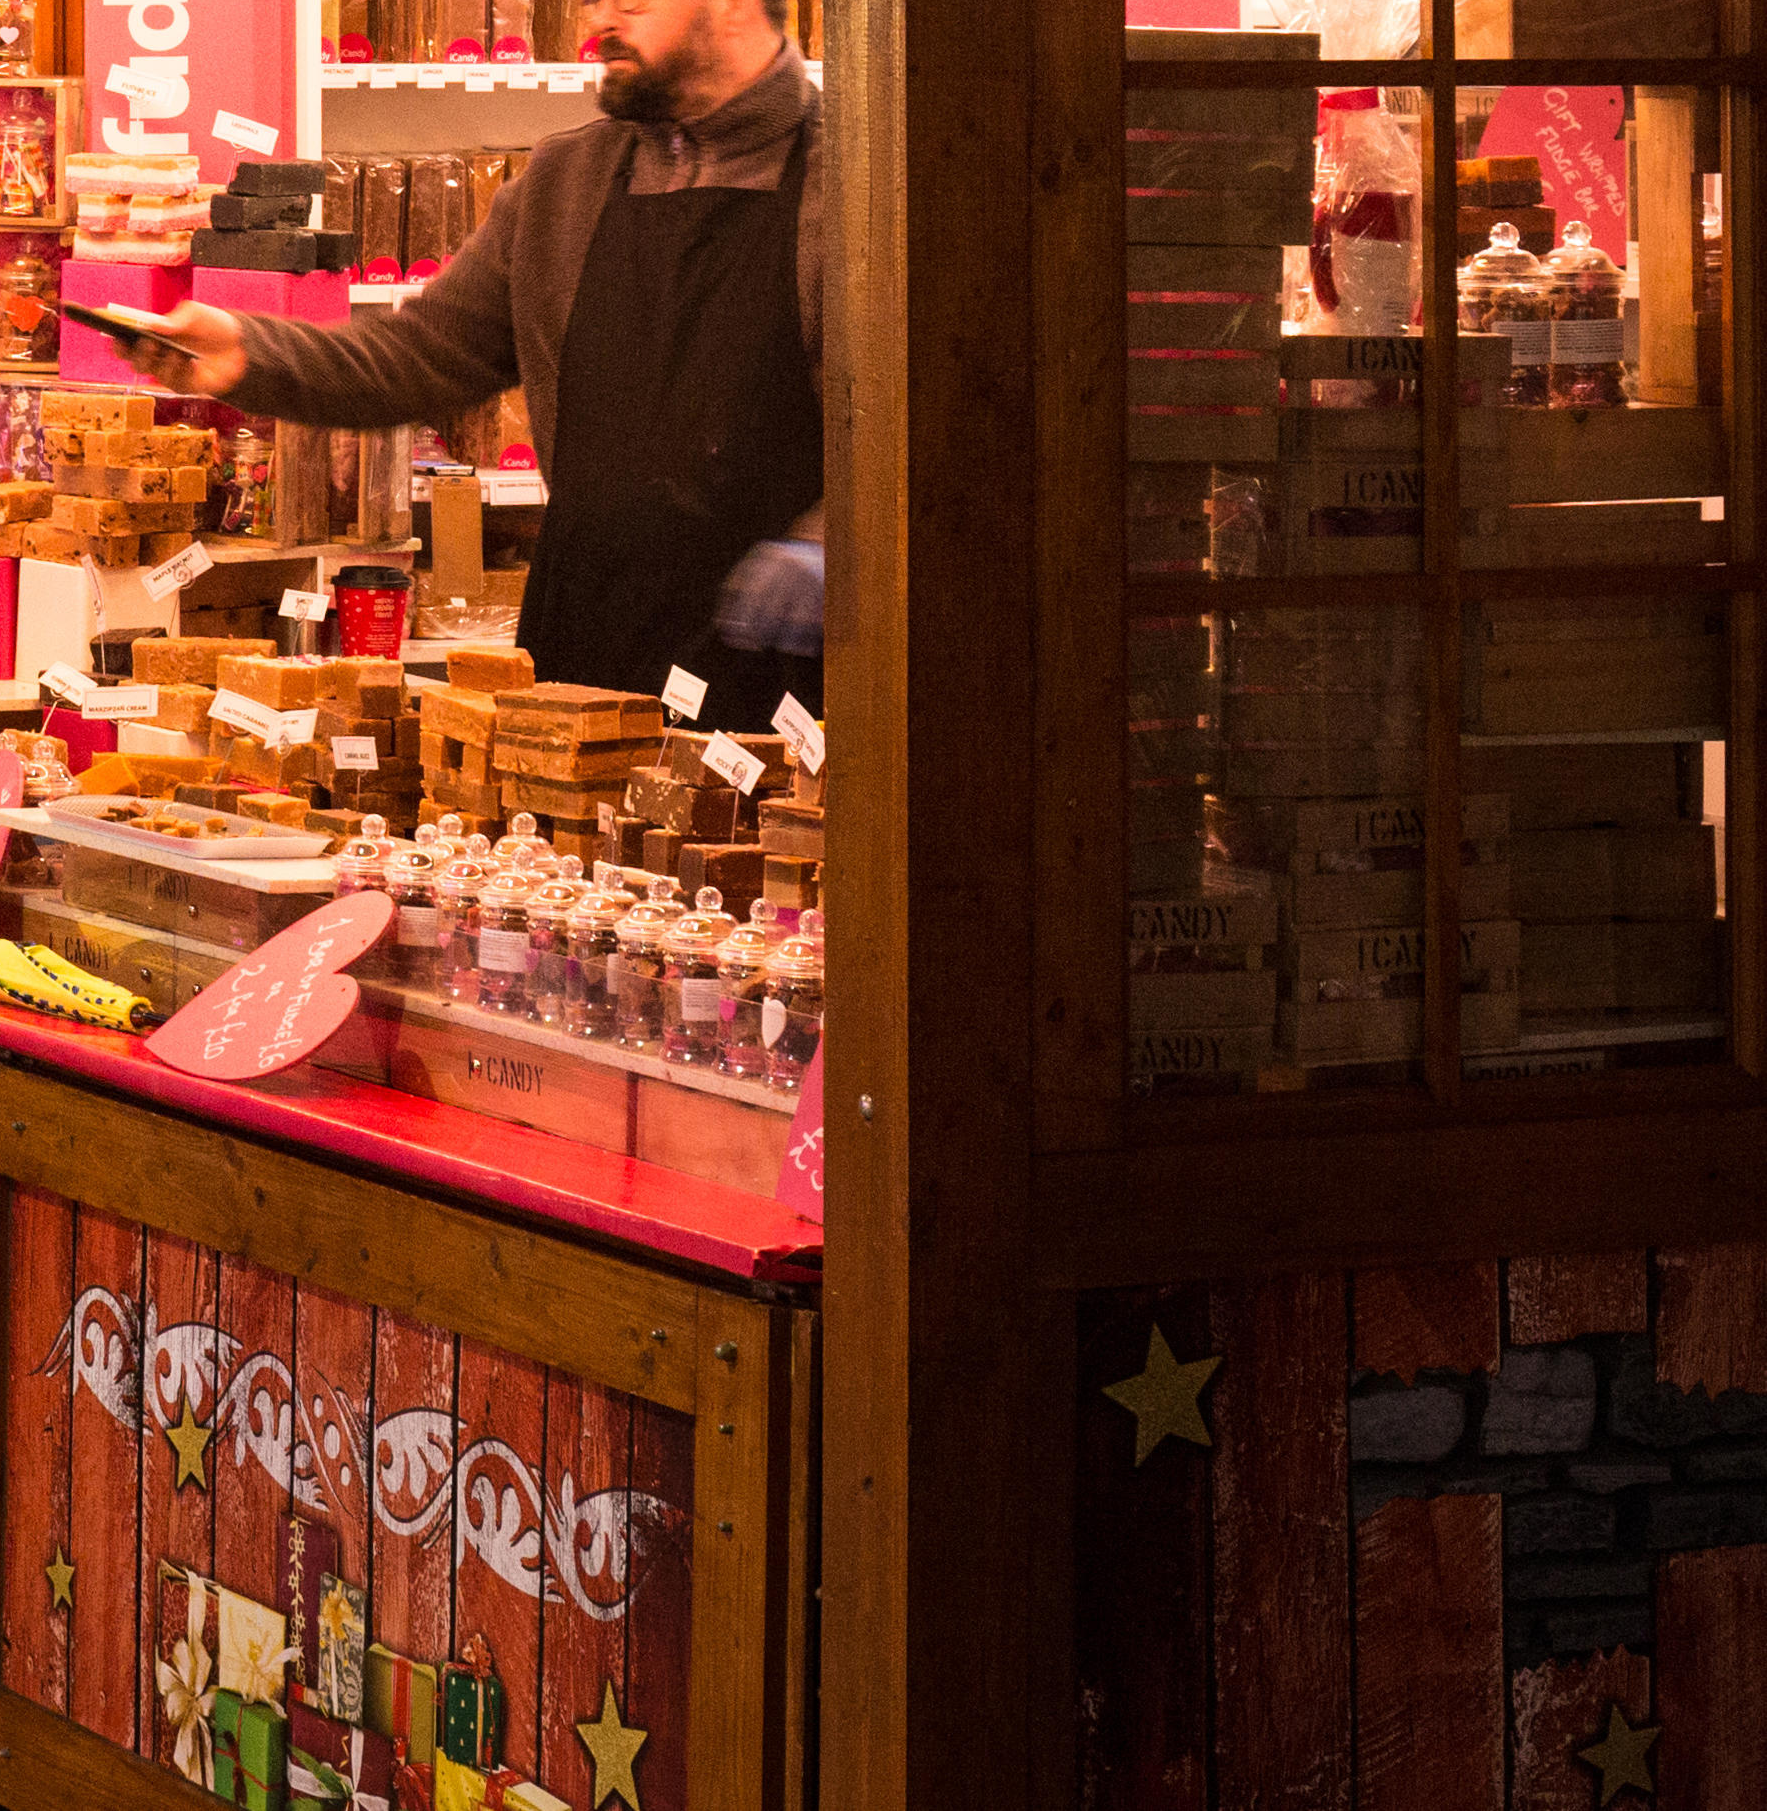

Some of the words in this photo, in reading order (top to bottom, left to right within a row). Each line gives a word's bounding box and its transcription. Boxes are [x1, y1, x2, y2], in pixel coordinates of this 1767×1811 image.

[449, 52, 478, 63] iCandy
[496, 50, 524, 61] iCandy
[1535, 126, 1583, 185] FUDGE
[368, 272, 395, 283] iCandy
[503, 459, 531, 468] iCandy
[1128, 905, 1232, 940] CANDY
[274, 991, 313, 1041] FUDGE
[486, 1055, 545, 1096] CANDY
